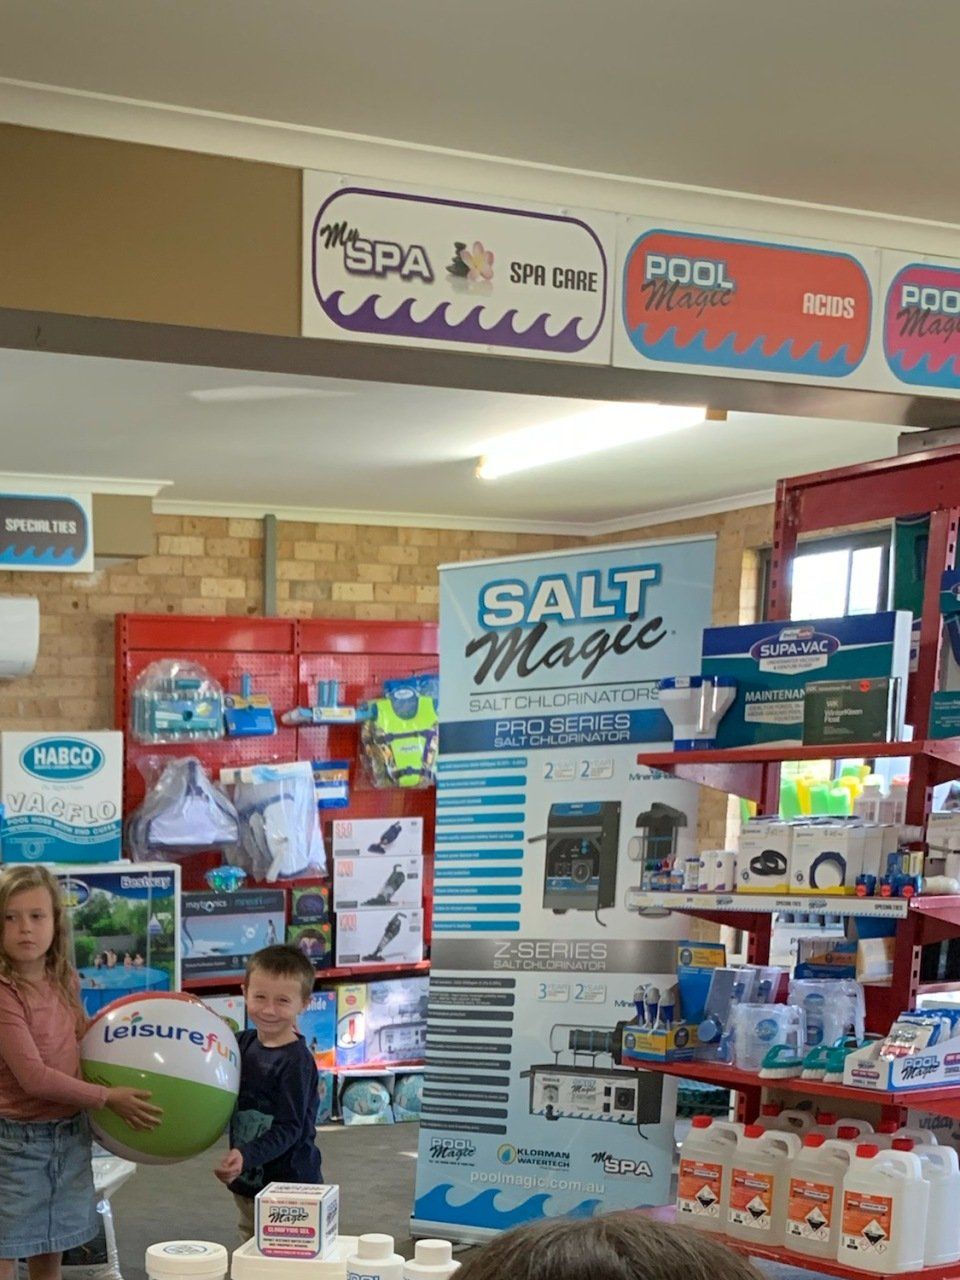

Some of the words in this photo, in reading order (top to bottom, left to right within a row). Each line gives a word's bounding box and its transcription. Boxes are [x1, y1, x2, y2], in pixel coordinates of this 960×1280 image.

[320, 221, 360, 250] My
[344, 238, 434, 282] SPA
[509, 261, 546, 287] SPA
[552, 265, 598, 292] CARE
[645, 255, 735, 290] POOL
[641, 281, 734, 318] Magic
[803, 292, 855, 319] ACIDS
[5, 517, 77, 534] SPECIALTIES
[480, 564, 660, 629] SALT
[465, 616, 667, 685] Magic
[760, 640, 828, 657] SUPA-VAC
[469, 697, 511, 713] SALT
[515, 687, 659, 710] CHLORINATORS
[495, 717, 544, 737] PRO
[549, 713, 630, 732] SERIES
[494, 734, 528, 748] SALT
[530, 730, 630, 746] CHLORINATOR
[34, 747, 94, 765] HABCO
[544, 762, 554, 779] 2
[581, 760, 590, 778] 2
[7, 792, 117, 824] VACFLO
[120, 875, 171, 889] Bestway
[185, 899, 227, 912] maytronics
[494, 943, 607, 960] Z-SERIES
[493, 960, 517, 970] SALT
[519, 960, 606, 971] CHLORINATOR
[538, 983, 547, 1000] 3
[575, 983, 584, 1000] 2
[103, 1020, 238, 1067] leisurefun
[903, 1056, 939, 1067] POOL
[901, 1065, 939, 1080] Magic
[431, 1137, 476, 1149] POOL
[430, 1146, 476, 1160] Magic
[517, 1148, 570, 1160] KLORMAN
[592, 1152, 613, 1163] My
[517, 1157, 570, 1168] WATERTECH
[604, 1159, 653, 1177] SPA
[470, 1170, 606, 1194] poolmagic.com.au
[268, 1213, 308, 1224] Magic
[269, 1206, 308, 1217] POOL
